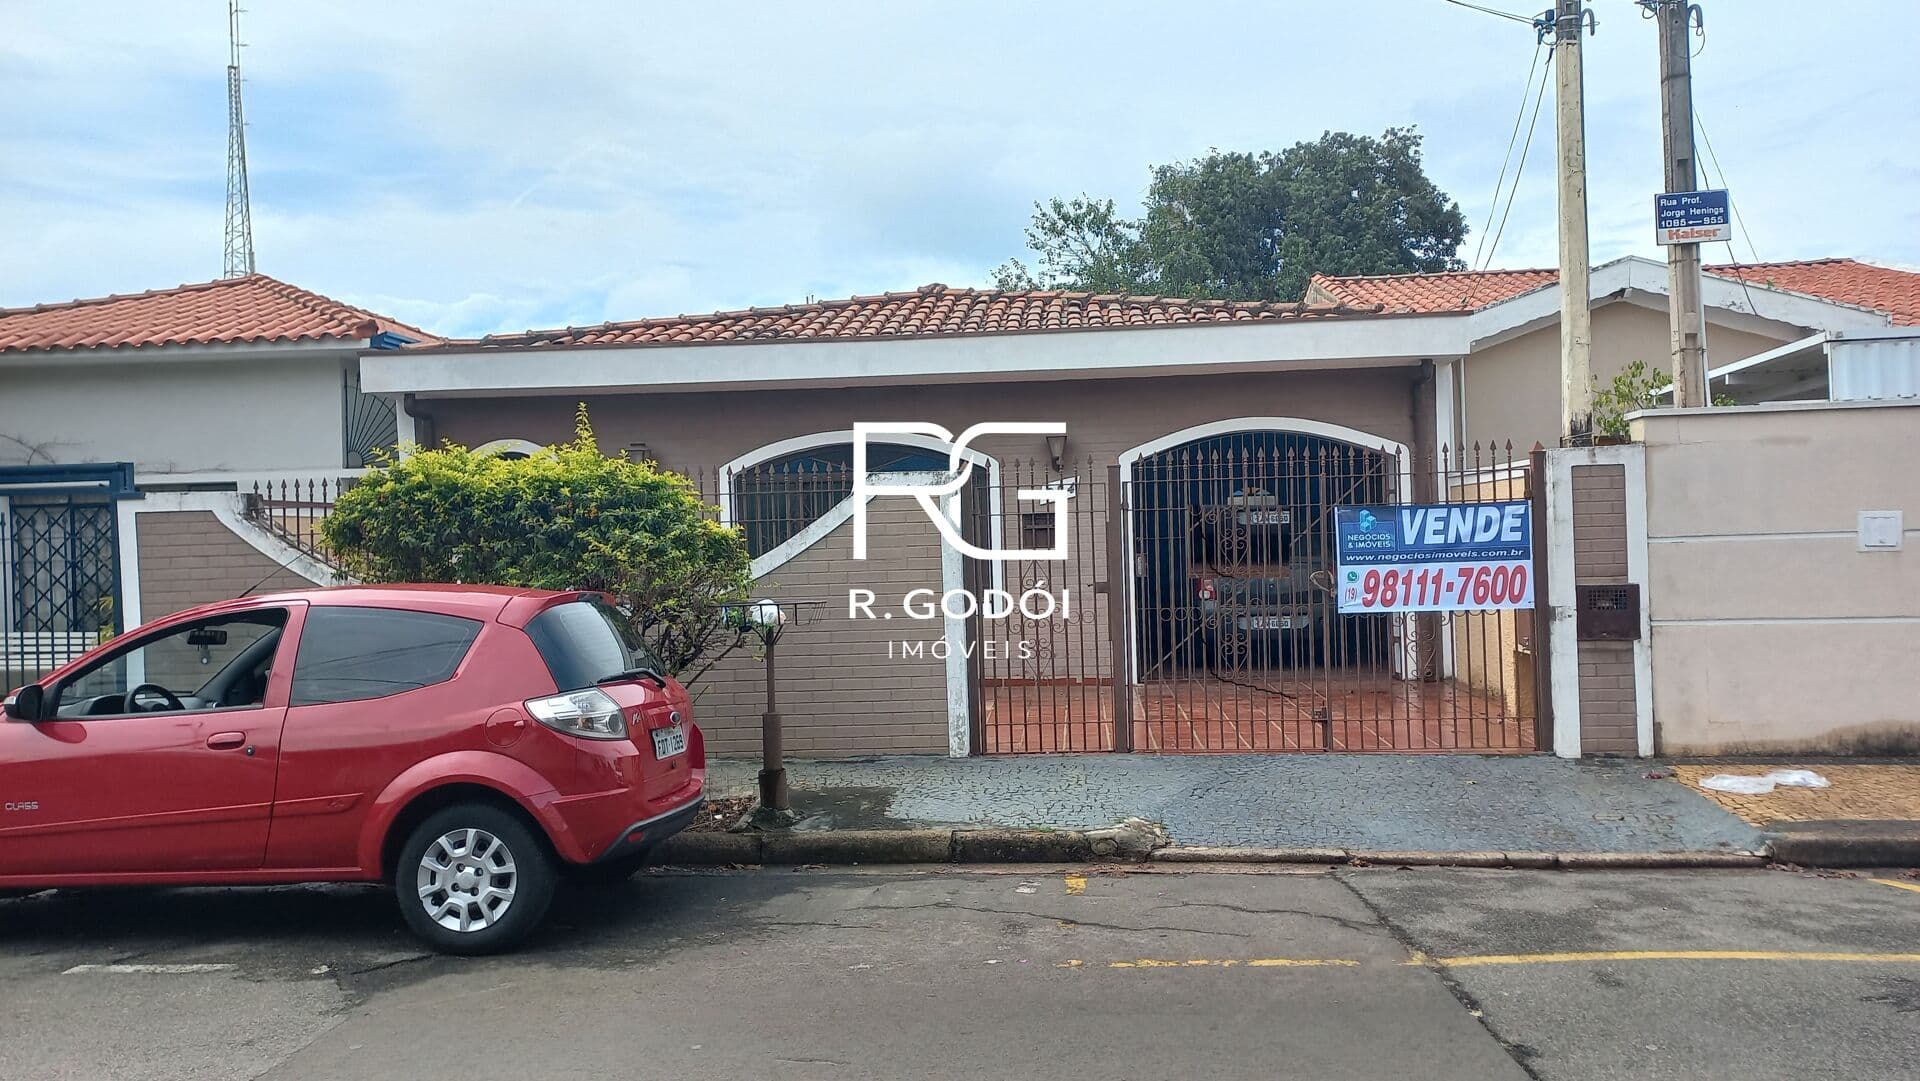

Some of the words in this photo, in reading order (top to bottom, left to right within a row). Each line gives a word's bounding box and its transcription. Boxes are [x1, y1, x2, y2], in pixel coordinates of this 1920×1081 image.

[1660, 198, 1677, 206] Rua
[1681, 196, 1702, 205] Prof.
[1661, 209, 1686, 217] Jorge
[1690, 206, 1724, 215] Henings
[1703, 216, 1723, 224] 955
[1667, 228, 1721, 240] Kaiser
[1401, 505, 1525, 544] VENDE
[1347, 533, 1391, 541] NEGÓCIOS
[1355, 540, 1391, 548] IMÓVEIS
[1345, 549, 1524, 562] www.negociosimoveis.com.br
[1344, 587, 1357, 603] (19)
[1362, 565, 1527, 608] 98111-7600
[5, 801, 38, 810] CLASS
